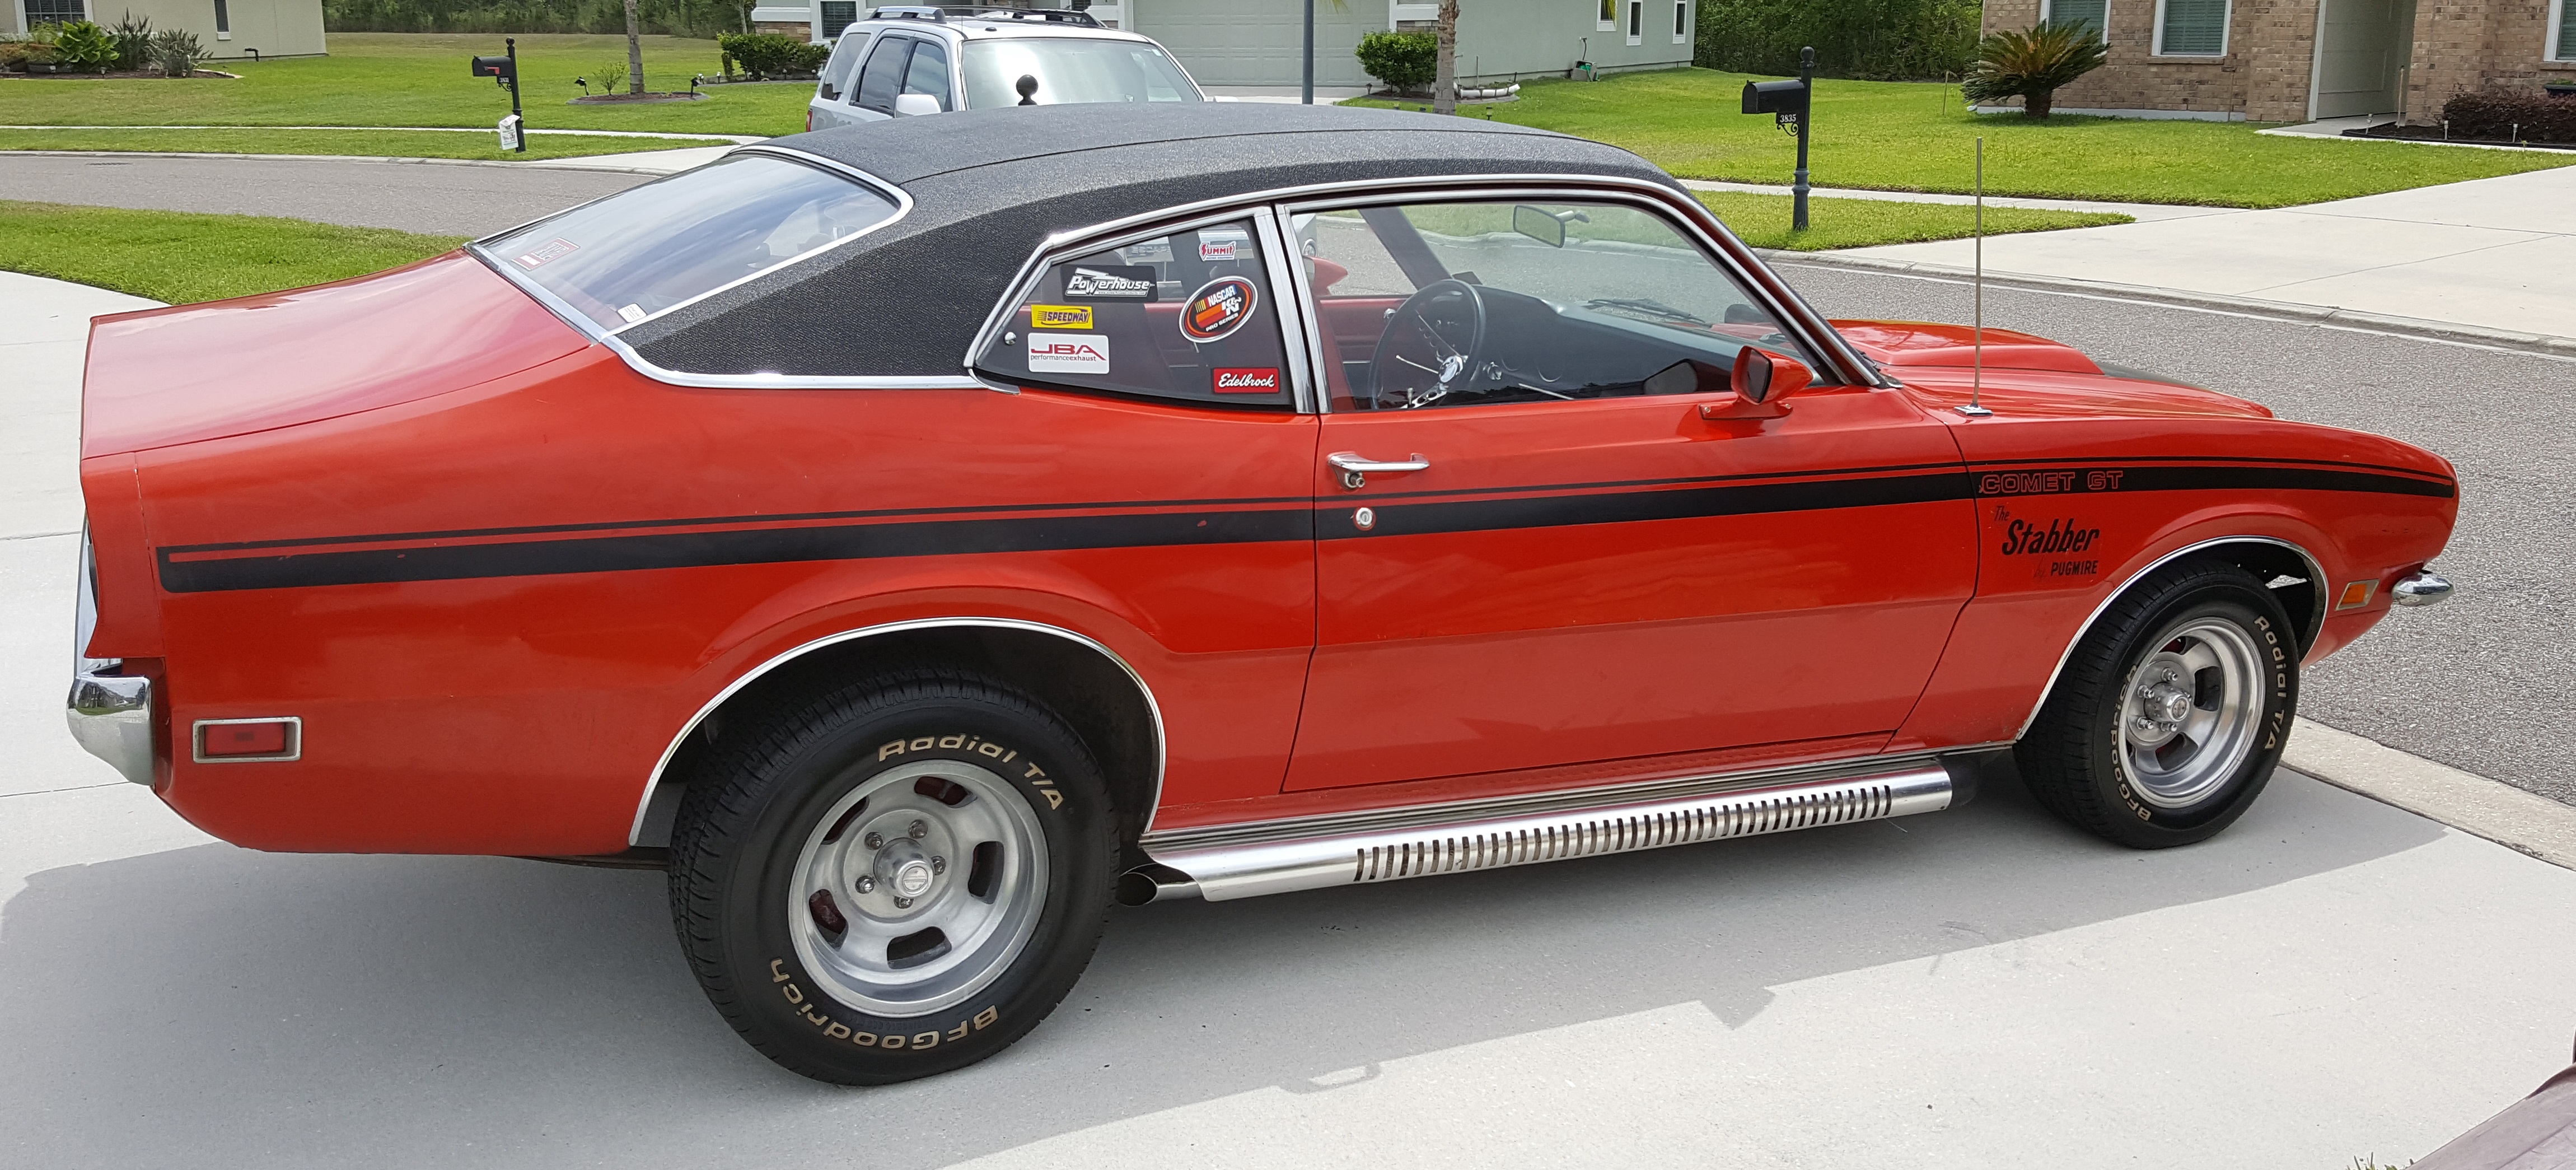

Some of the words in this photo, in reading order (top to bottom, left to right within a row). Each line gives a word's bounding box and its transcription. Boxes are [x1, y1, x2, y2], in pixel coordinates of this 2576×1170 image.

[1780, 113, 1797, 123] 3835
[1201, 244, 1233, 257] SUMMIT
[1067, 276, 1151, 295] Powerhouse
[1207, 284, 1235, 307] NASCAR
[1047, 311, 1088, 323] SPEEDWAY
[1205, 323, 1218, 332] PRO
[1218, 313, 1238, 327] SERIES
[1031, 344, 1106, 361] JBA
[1218, 372, 1275, 388] Edelbrock
[1981, 472, 2075, 494] COMET
[2087, 470, 2123, 490] GT
[1994, 505, 2010, 521] The
[2002, 518, 2100, 555] Stabber
[2050, 560, 2098, 576] PUGMIRE
[2254, 616, 2287, 698] Radial
[2264, 709, 2285, 750] T/A
[878, 734, 1017, 762] Radial
[1023, 761, 1064, 810] T/A
[770, 958, 999, 1051] BFGoodrich
